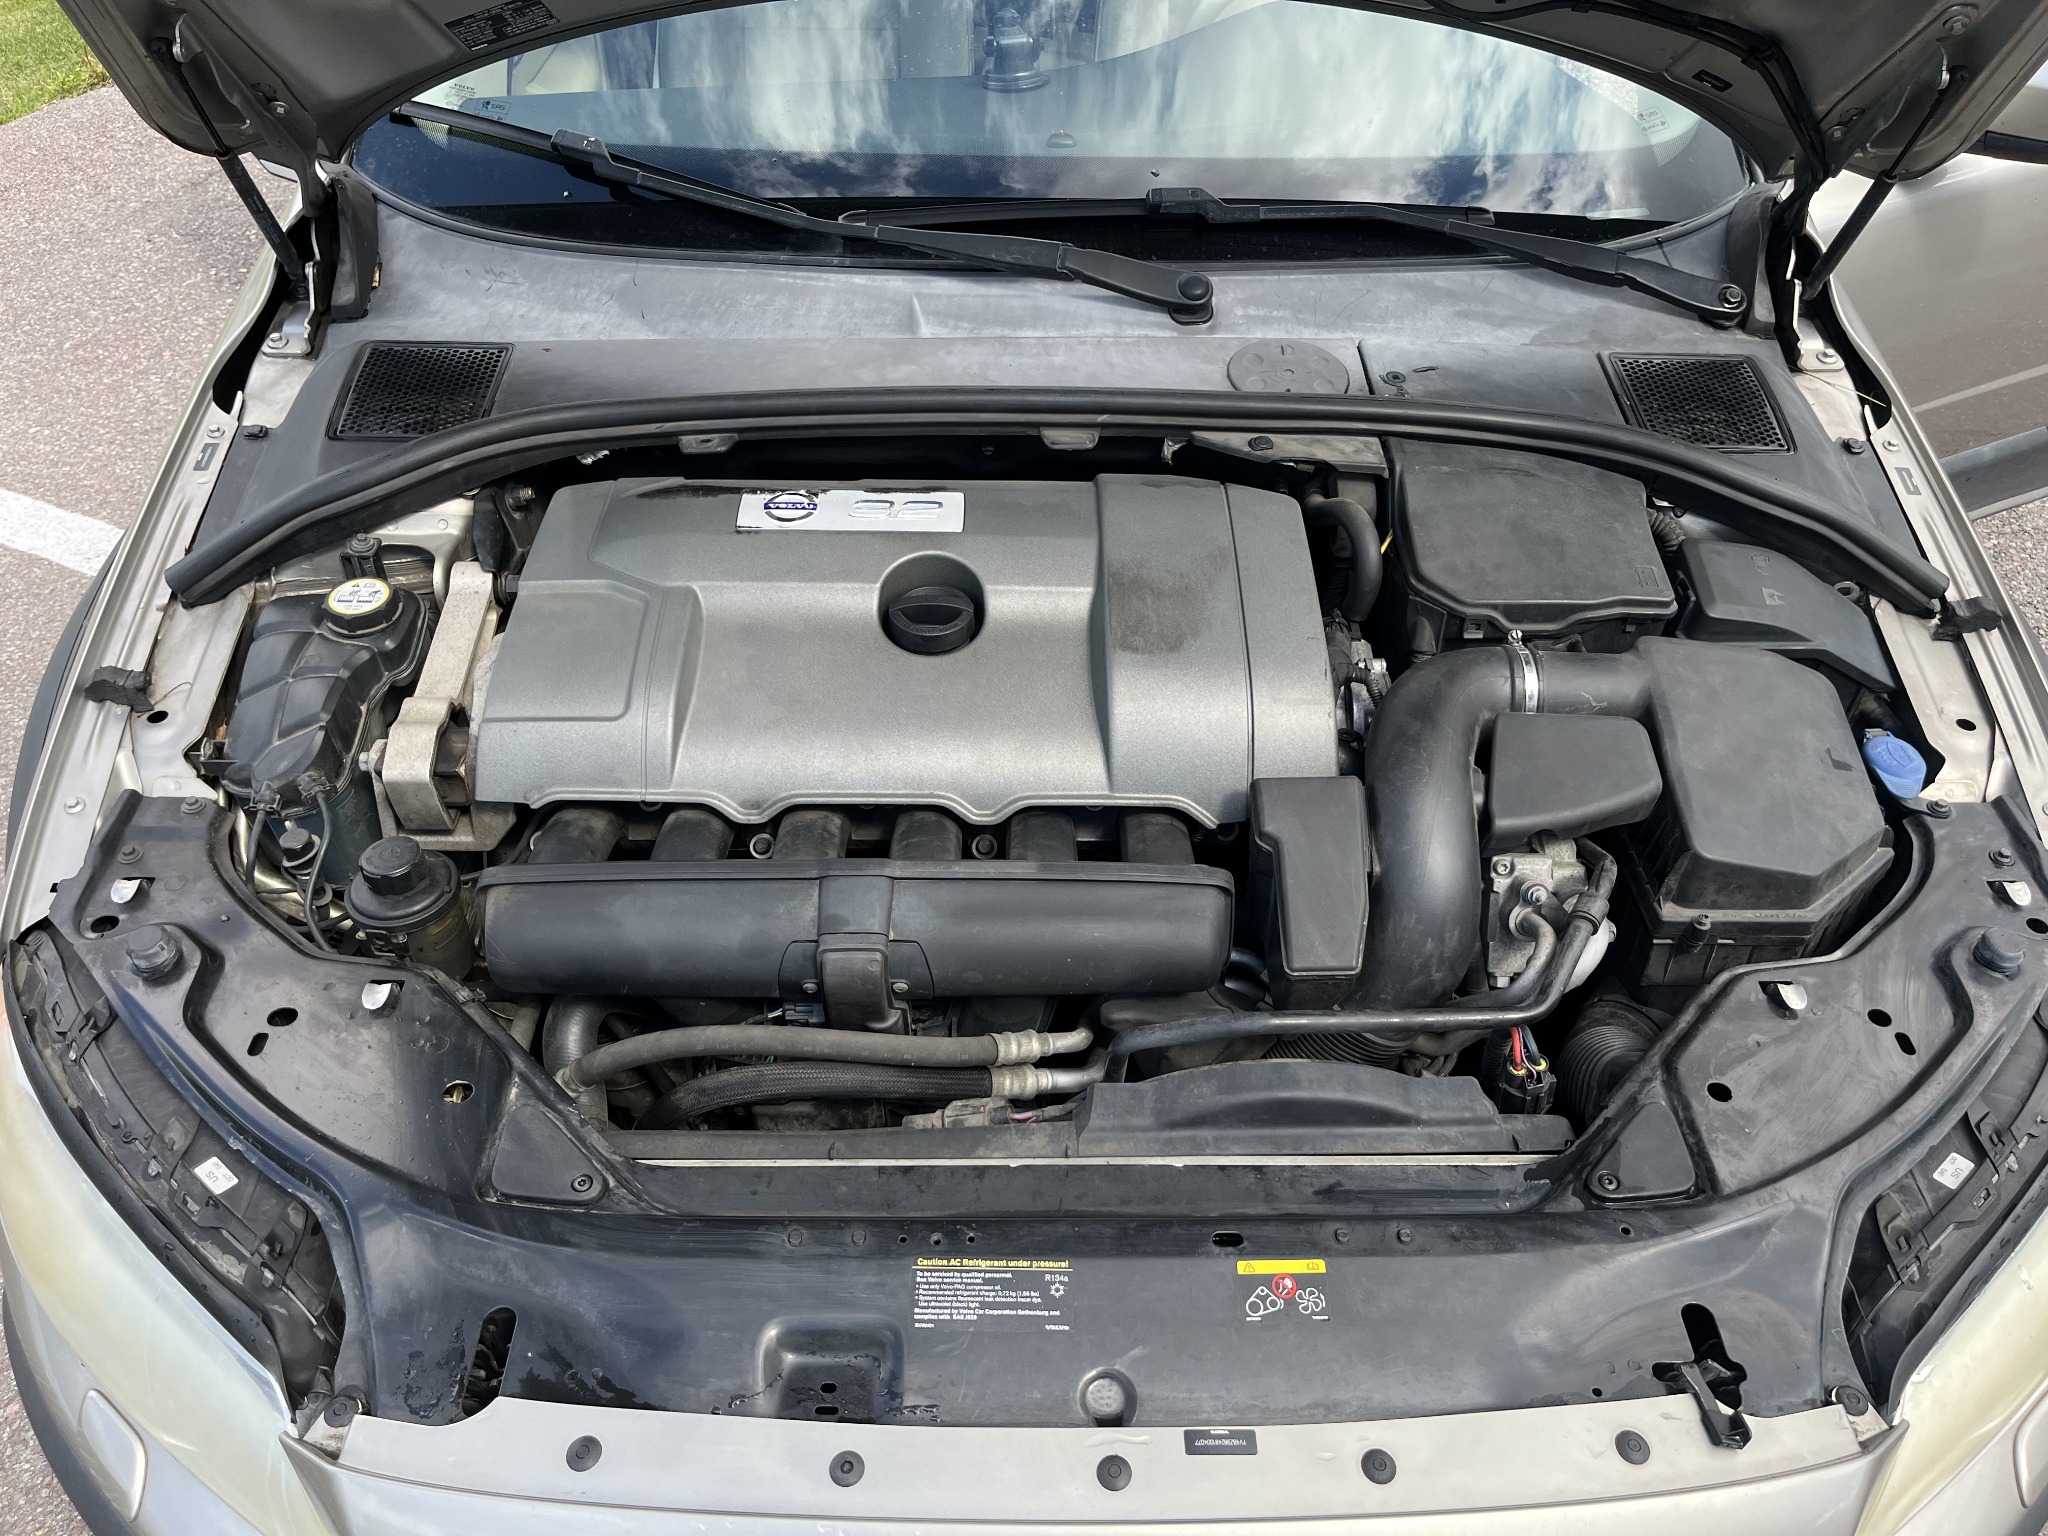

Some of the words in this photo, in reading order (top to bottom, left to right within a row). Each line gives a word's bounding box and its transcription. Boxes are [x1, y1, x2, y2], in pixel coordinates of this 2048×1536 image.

[453, 83, 475, 91] VOLVO
[848, 499, 944, 520] 3.2
[205, 1171, 219, 1183] US
[1950, 1167, 1964, 1179] US
[917, 1257, 948, 1266] Caution
[949, 1258, 961, 1266] AC
[962, 1258, 1007, 1267] Refrigerant
[1008, 1259, 1031, 1267] under
[1032, 1260, 1069, 1269] pressure!
[1045, 1273, 1069, 1282] R134a
